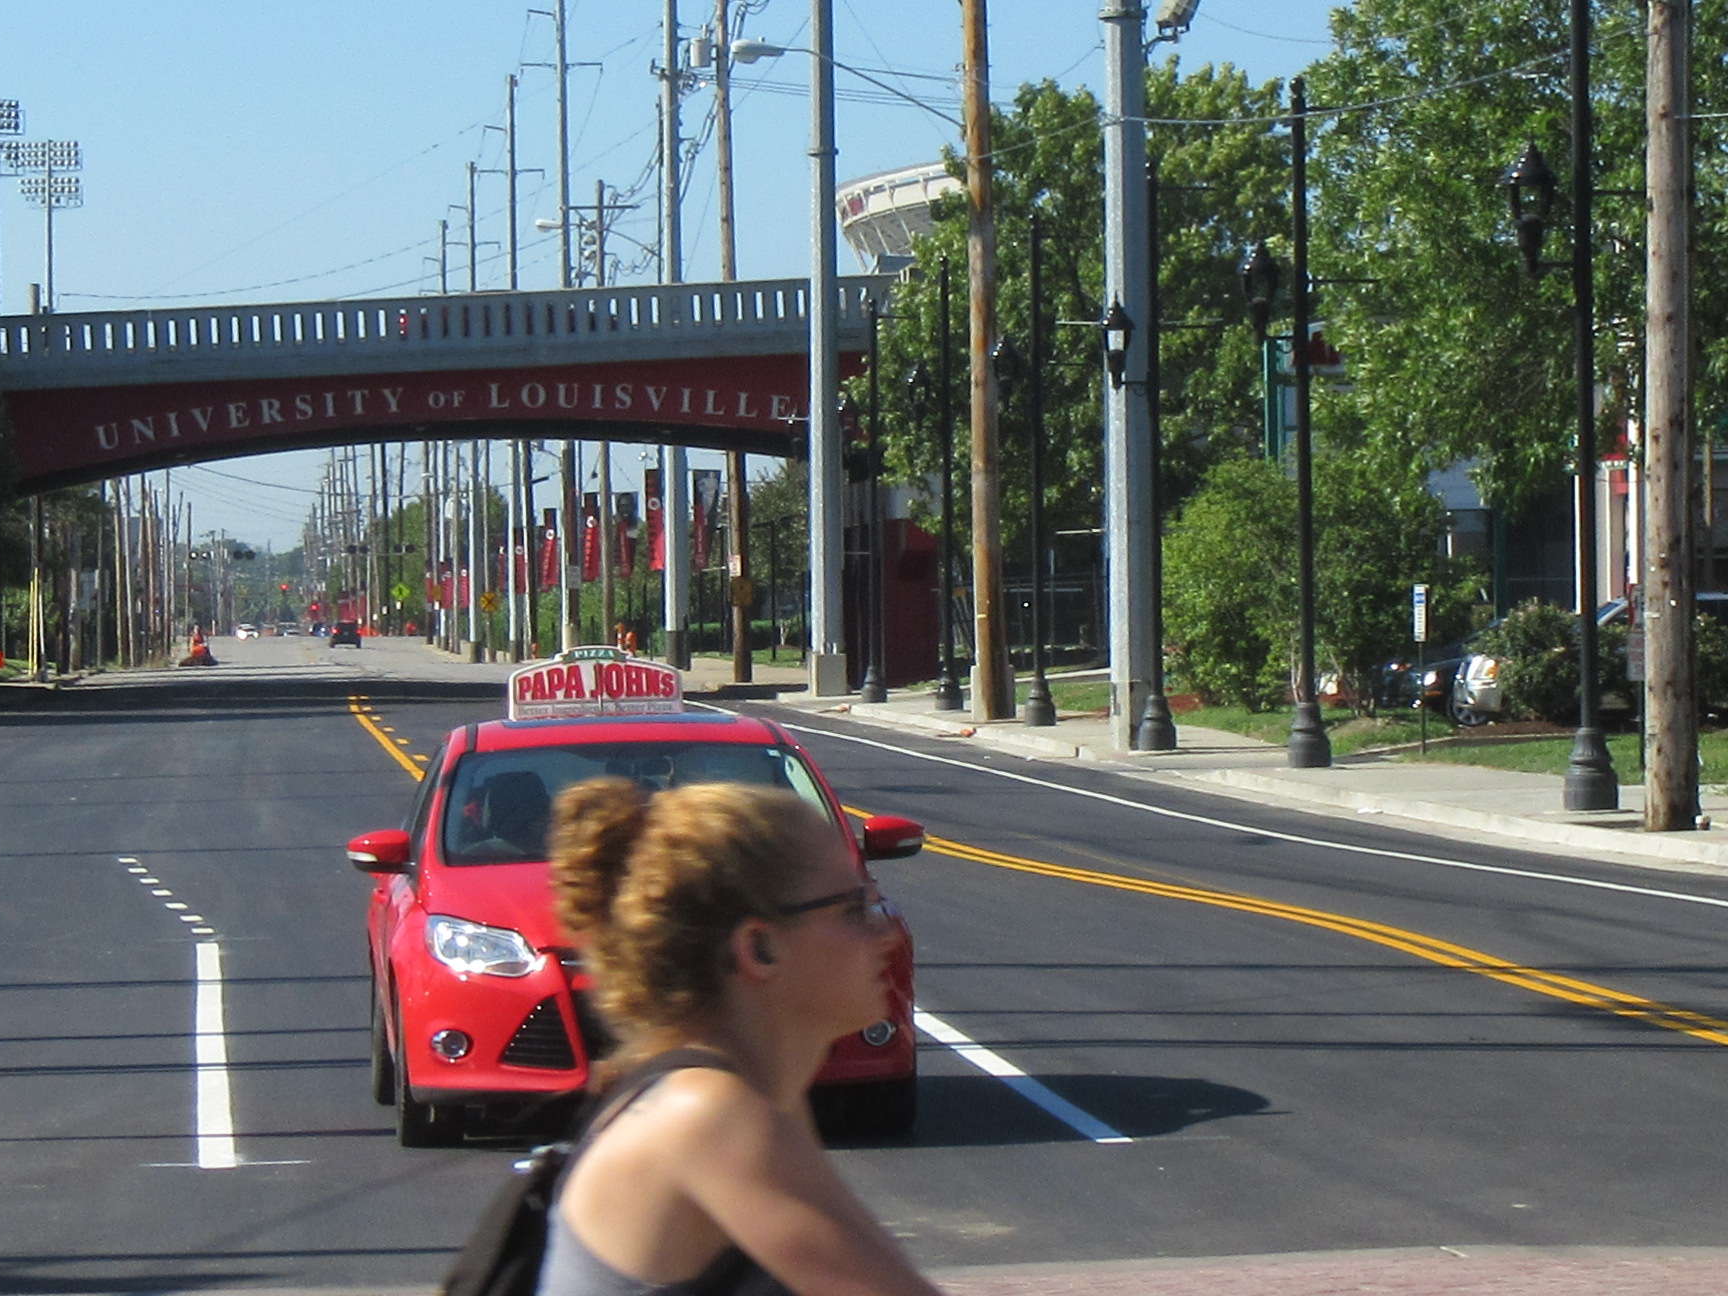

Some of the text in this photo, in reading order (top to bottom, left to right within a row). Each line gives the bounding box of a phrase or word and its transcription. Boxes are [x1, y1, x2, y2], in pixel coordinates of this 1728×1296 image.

[95, 382, 798, 451] UNIVERSITY OF LOUISVILLE
[574, 649, 615, 659] PIZZA
[518, 664, 585, 701] PAPA
